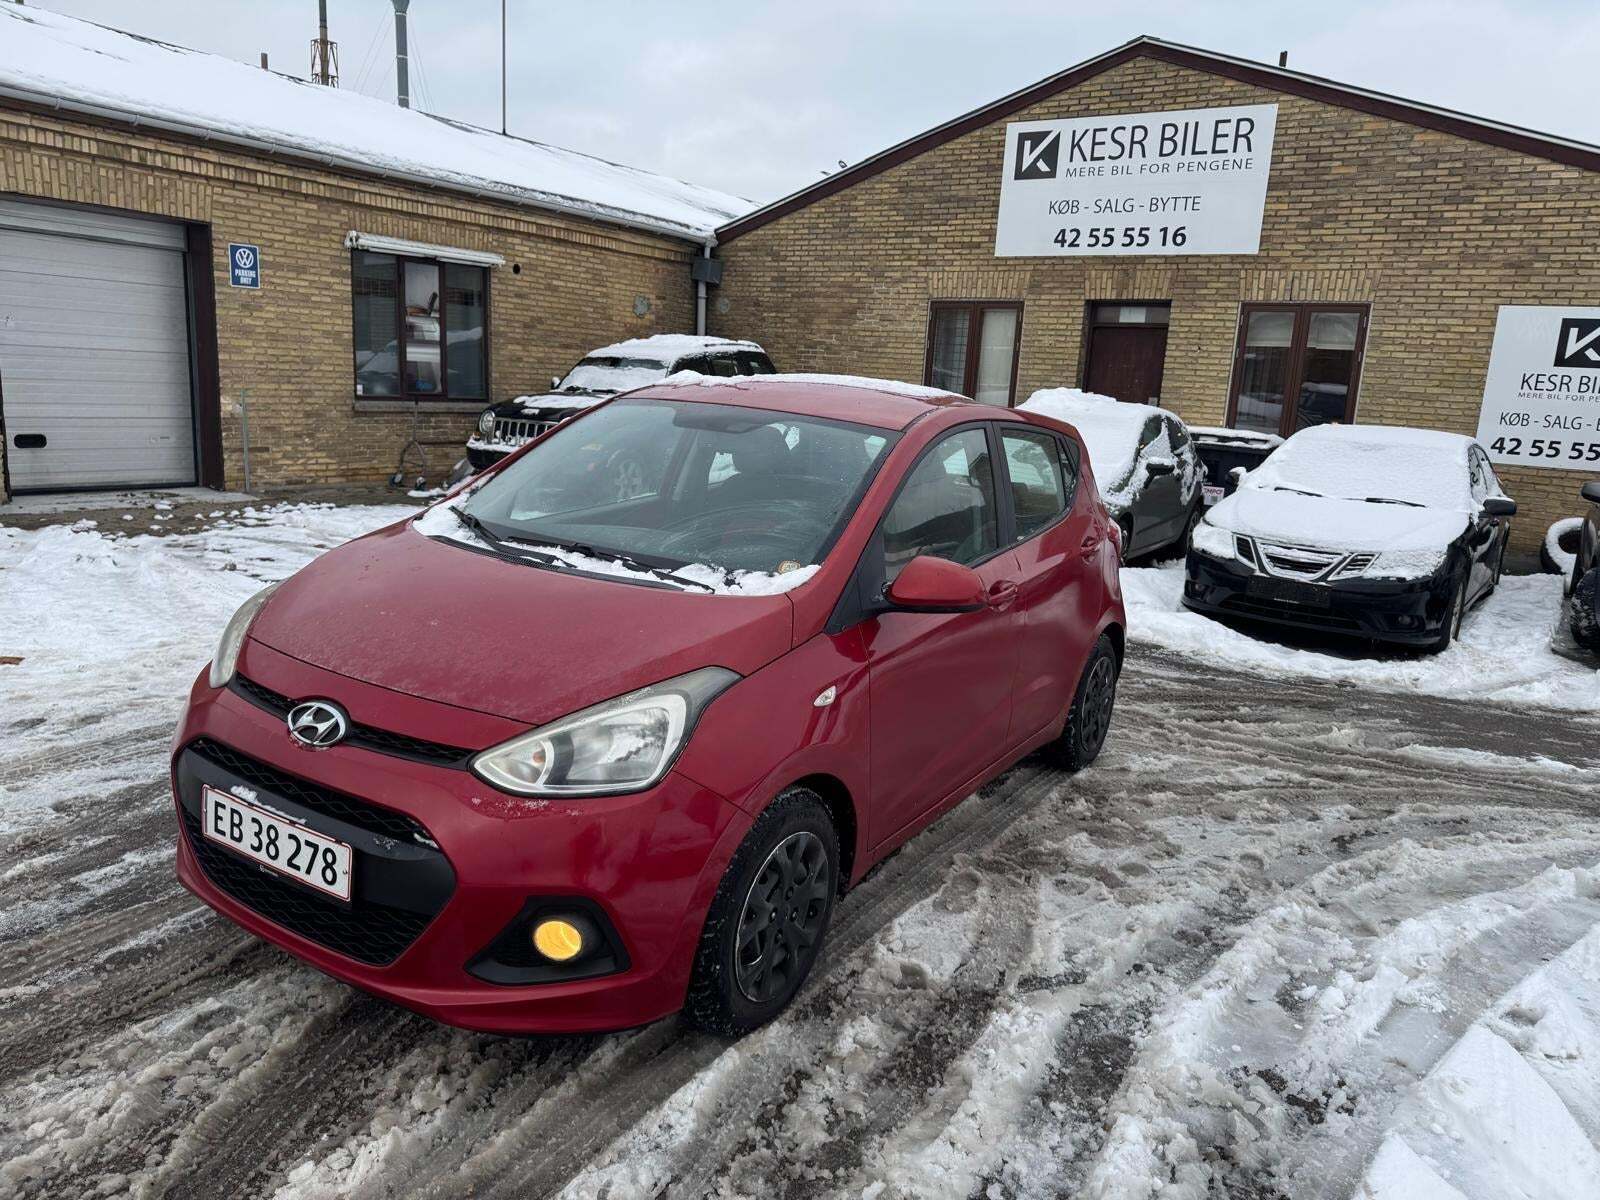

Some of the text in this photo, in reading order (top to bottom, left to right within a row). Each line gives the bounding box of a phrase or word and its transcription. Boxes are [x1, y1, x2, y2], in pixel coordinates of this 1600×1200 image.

[1069, 117, 1255, 163] KESR BILER
[1065, 158, 1254, 178] MERE BIL FOR PENGENE
[1048, 199, 1080, 215] KØB
[1093, 198, 1134, 214] SALG
[1149, 196, 1201, 212] BYTTE
[1053, 226, 1187, 248] 42 55 55 16
[1520, 373, 1600, 394] KESR BI
[1518, 392, 1543, 400] MERE
[1565, 394, 1585, 402] FOR
[1499, 412, 1530, 427] KØB
[1542, 414, 1584, 430] SALG
[1490, 437, 1600, 461] 42 55 55
[214, 800, 337, 886] EB 38 278
